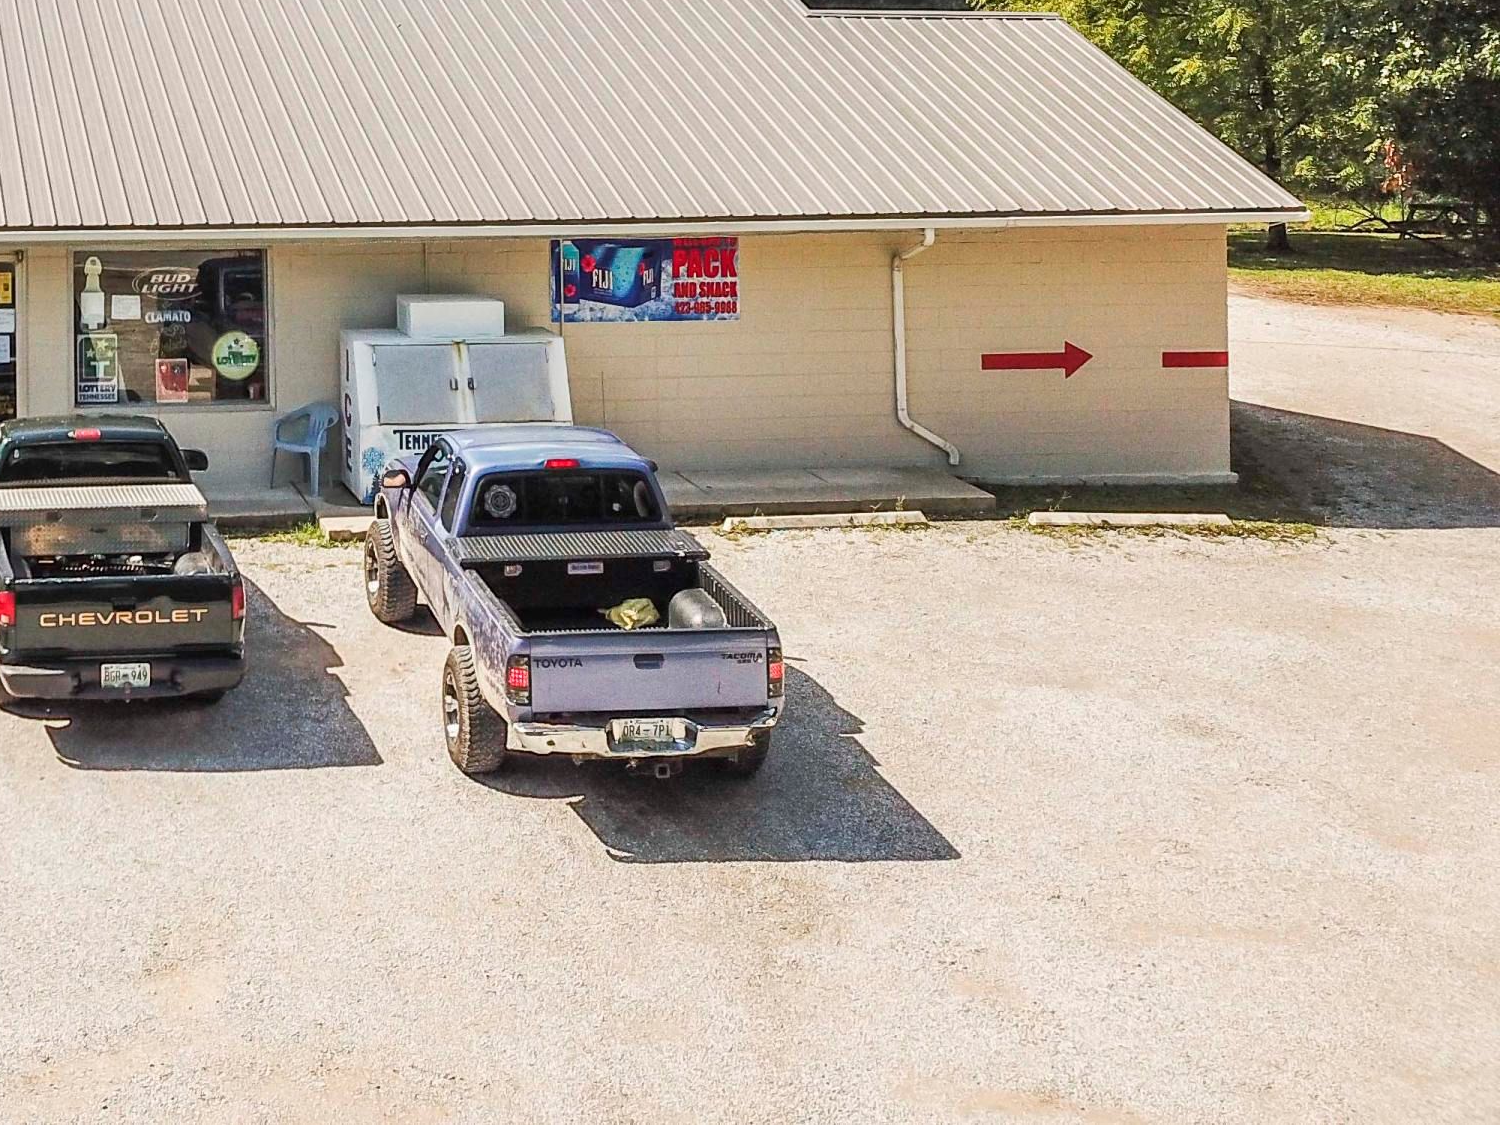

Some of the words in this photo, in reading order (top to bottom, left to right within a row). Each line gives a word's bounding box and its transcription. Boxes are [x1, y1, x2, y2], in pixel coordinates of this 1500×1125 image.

[672, 248, 738, 279] PACK
[592, 269, 613, 289] FIJI
[141, 284, 198, 293] LIGHT
[674, 282, 697, 298] AND
[699, 282, 738, 297] SNACK
[145, 309, 191, 323] CLAMATO
[344, 349, 352, 472] ICE
[39, 609, 208, 627] CHEVROLET
[534, 658, 583, 668] TOYOTA
